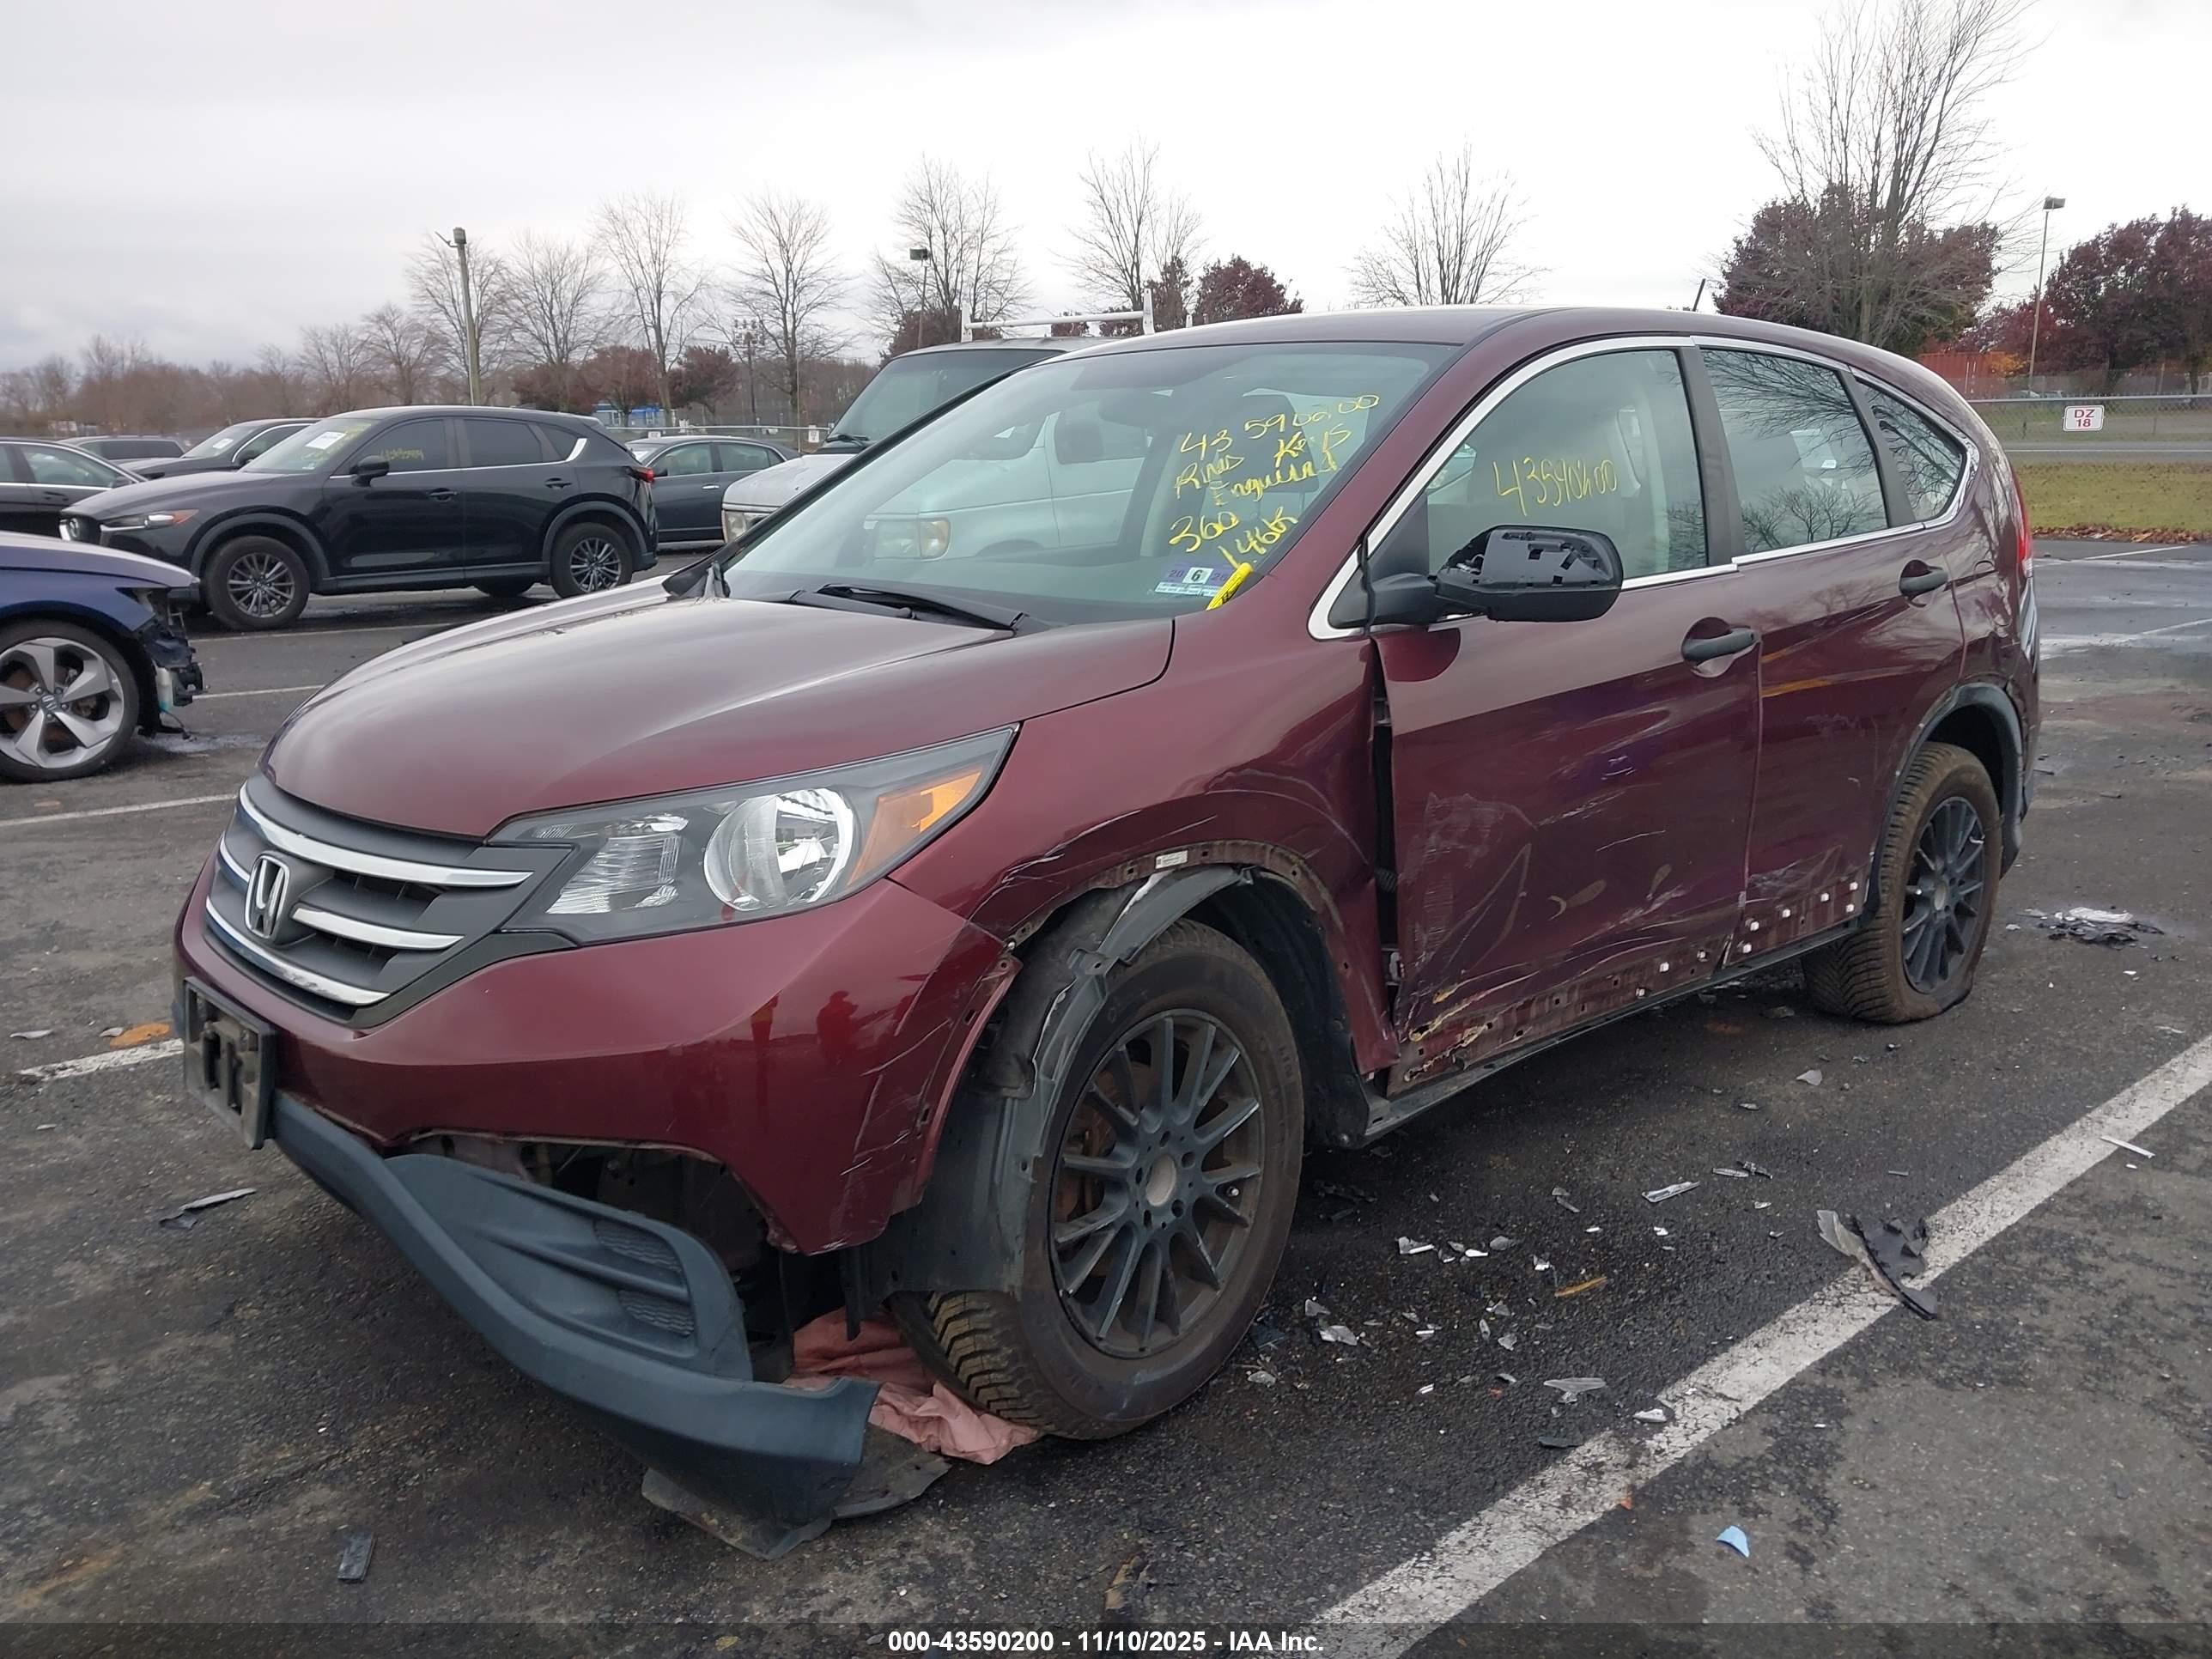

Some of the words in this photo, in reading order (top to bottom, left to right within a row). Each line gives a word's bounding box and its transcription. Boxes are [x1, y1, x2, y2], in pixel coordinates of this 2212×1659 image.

[2074, 409, 2095, 418] DZ
[2076, 419, 2091, 428] 18
[1191, 569, 1203, 582] 6
